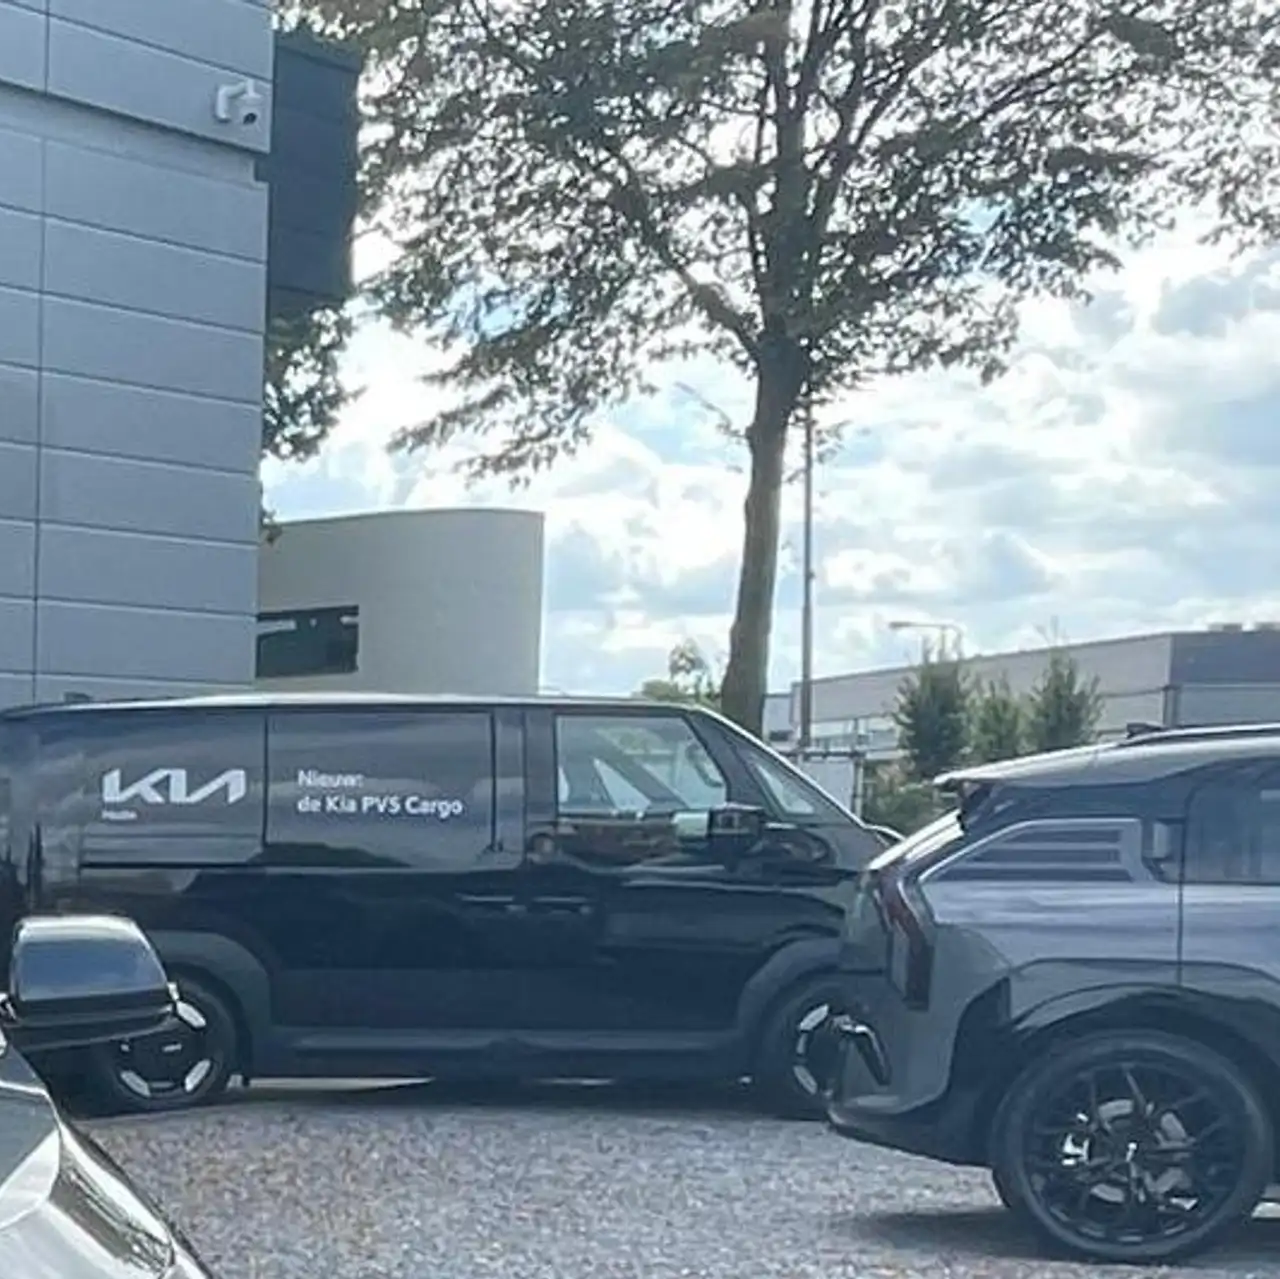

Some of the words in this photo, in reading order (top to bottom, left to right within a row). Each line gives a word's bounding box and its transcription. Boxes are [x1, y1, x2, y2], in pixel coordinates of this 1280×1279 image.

[102, 768, 246, 804] KIA
[297, 796, 321, 812] de
[325, 796, 357, 813] Kia
[405, 796, 463, 818] Cargo
